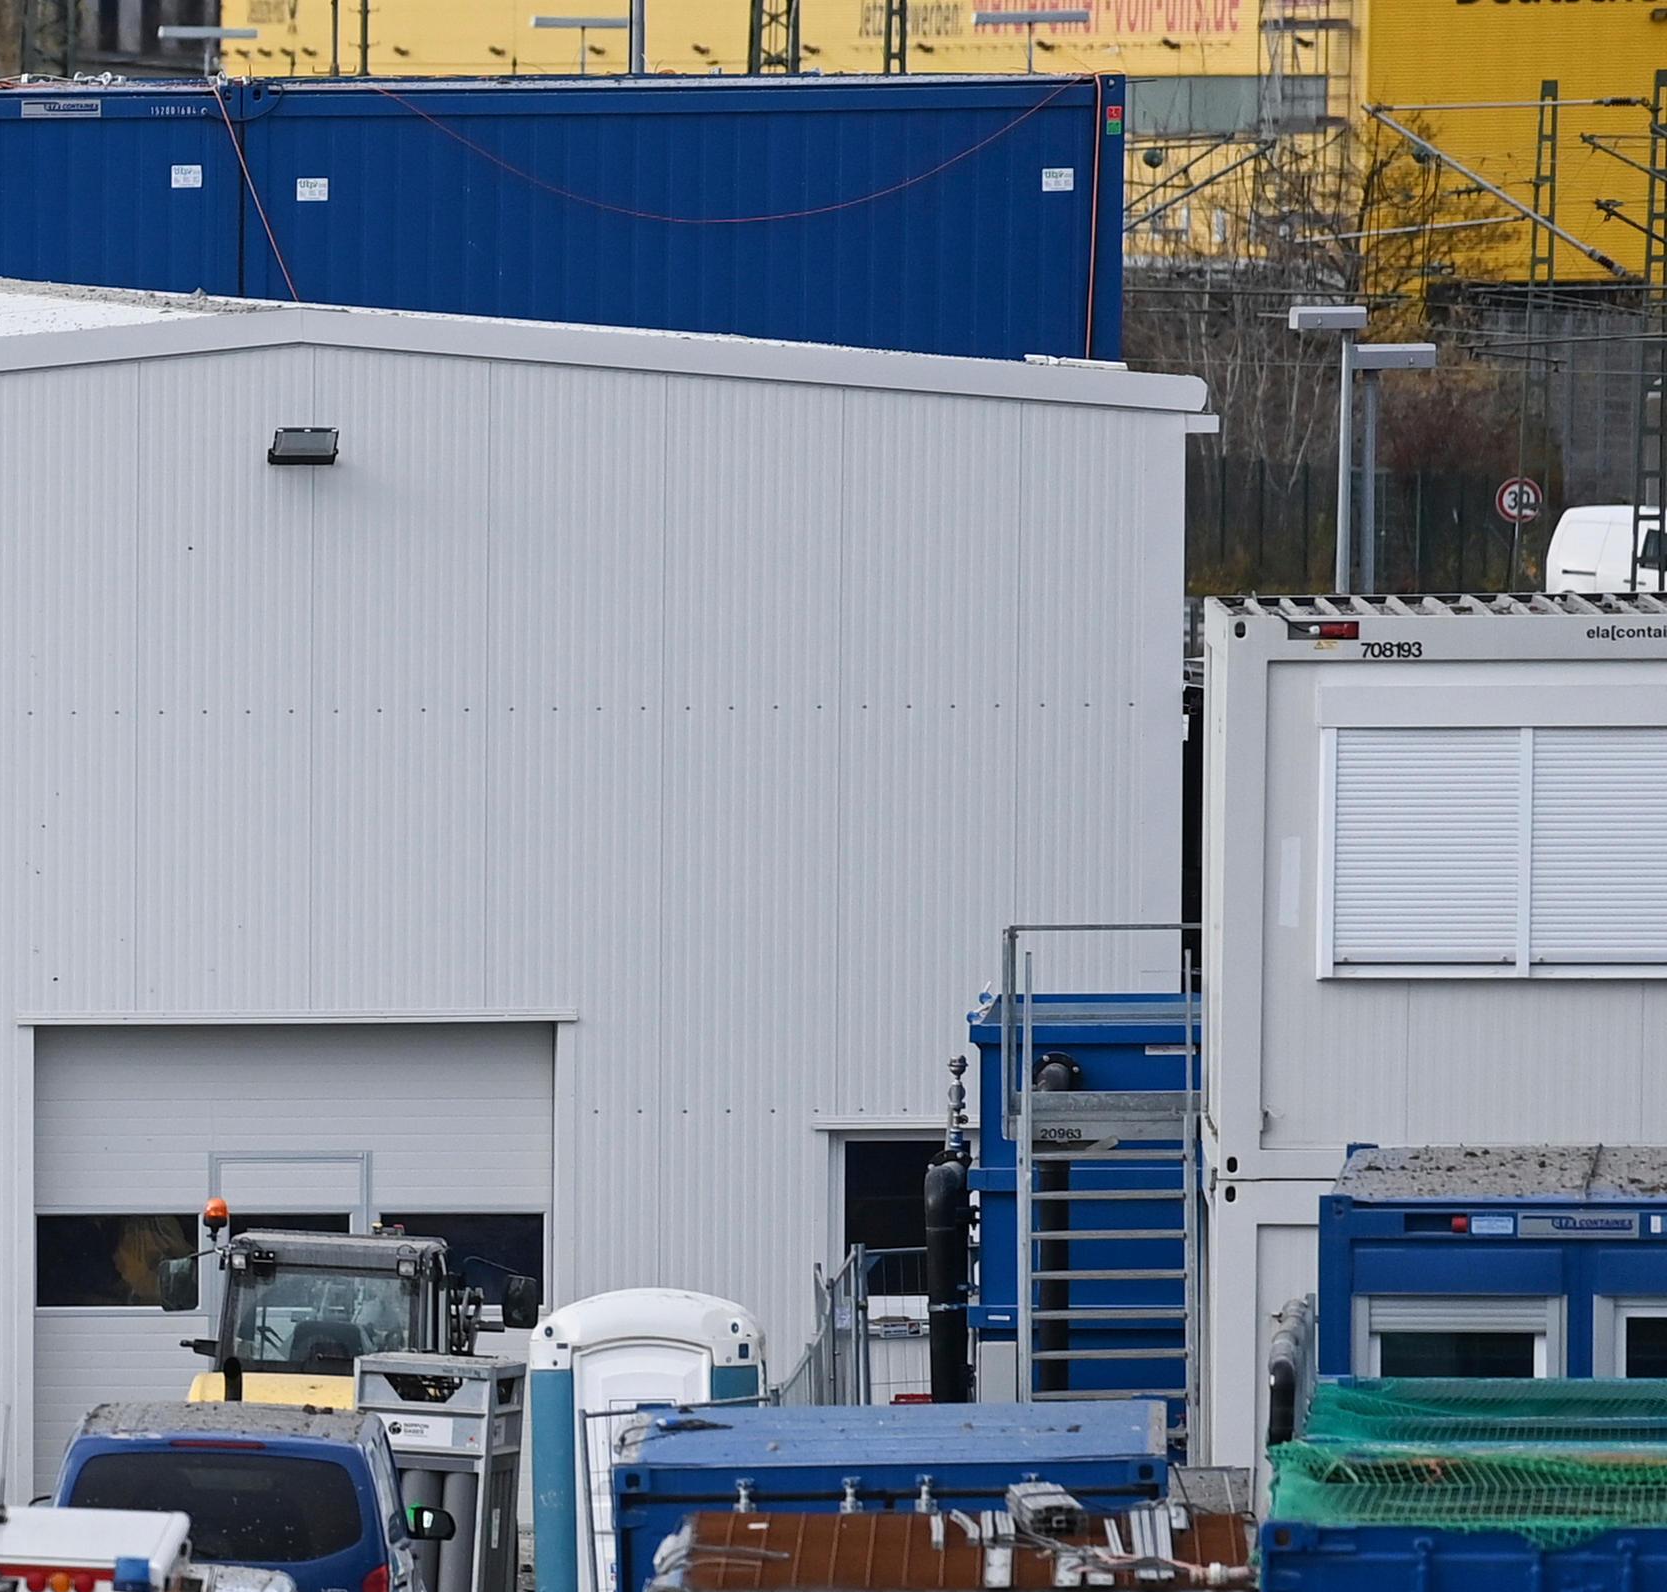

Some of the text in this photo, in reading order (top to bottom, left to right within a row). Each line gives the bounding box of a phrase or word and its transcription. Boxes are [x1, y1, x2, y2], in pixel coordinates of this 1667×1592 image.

[1507, 491, 1530, 510] 30
[1361, 641, 1422, 658] 708193
[1039, 1128, 1082, 1139] 20963
